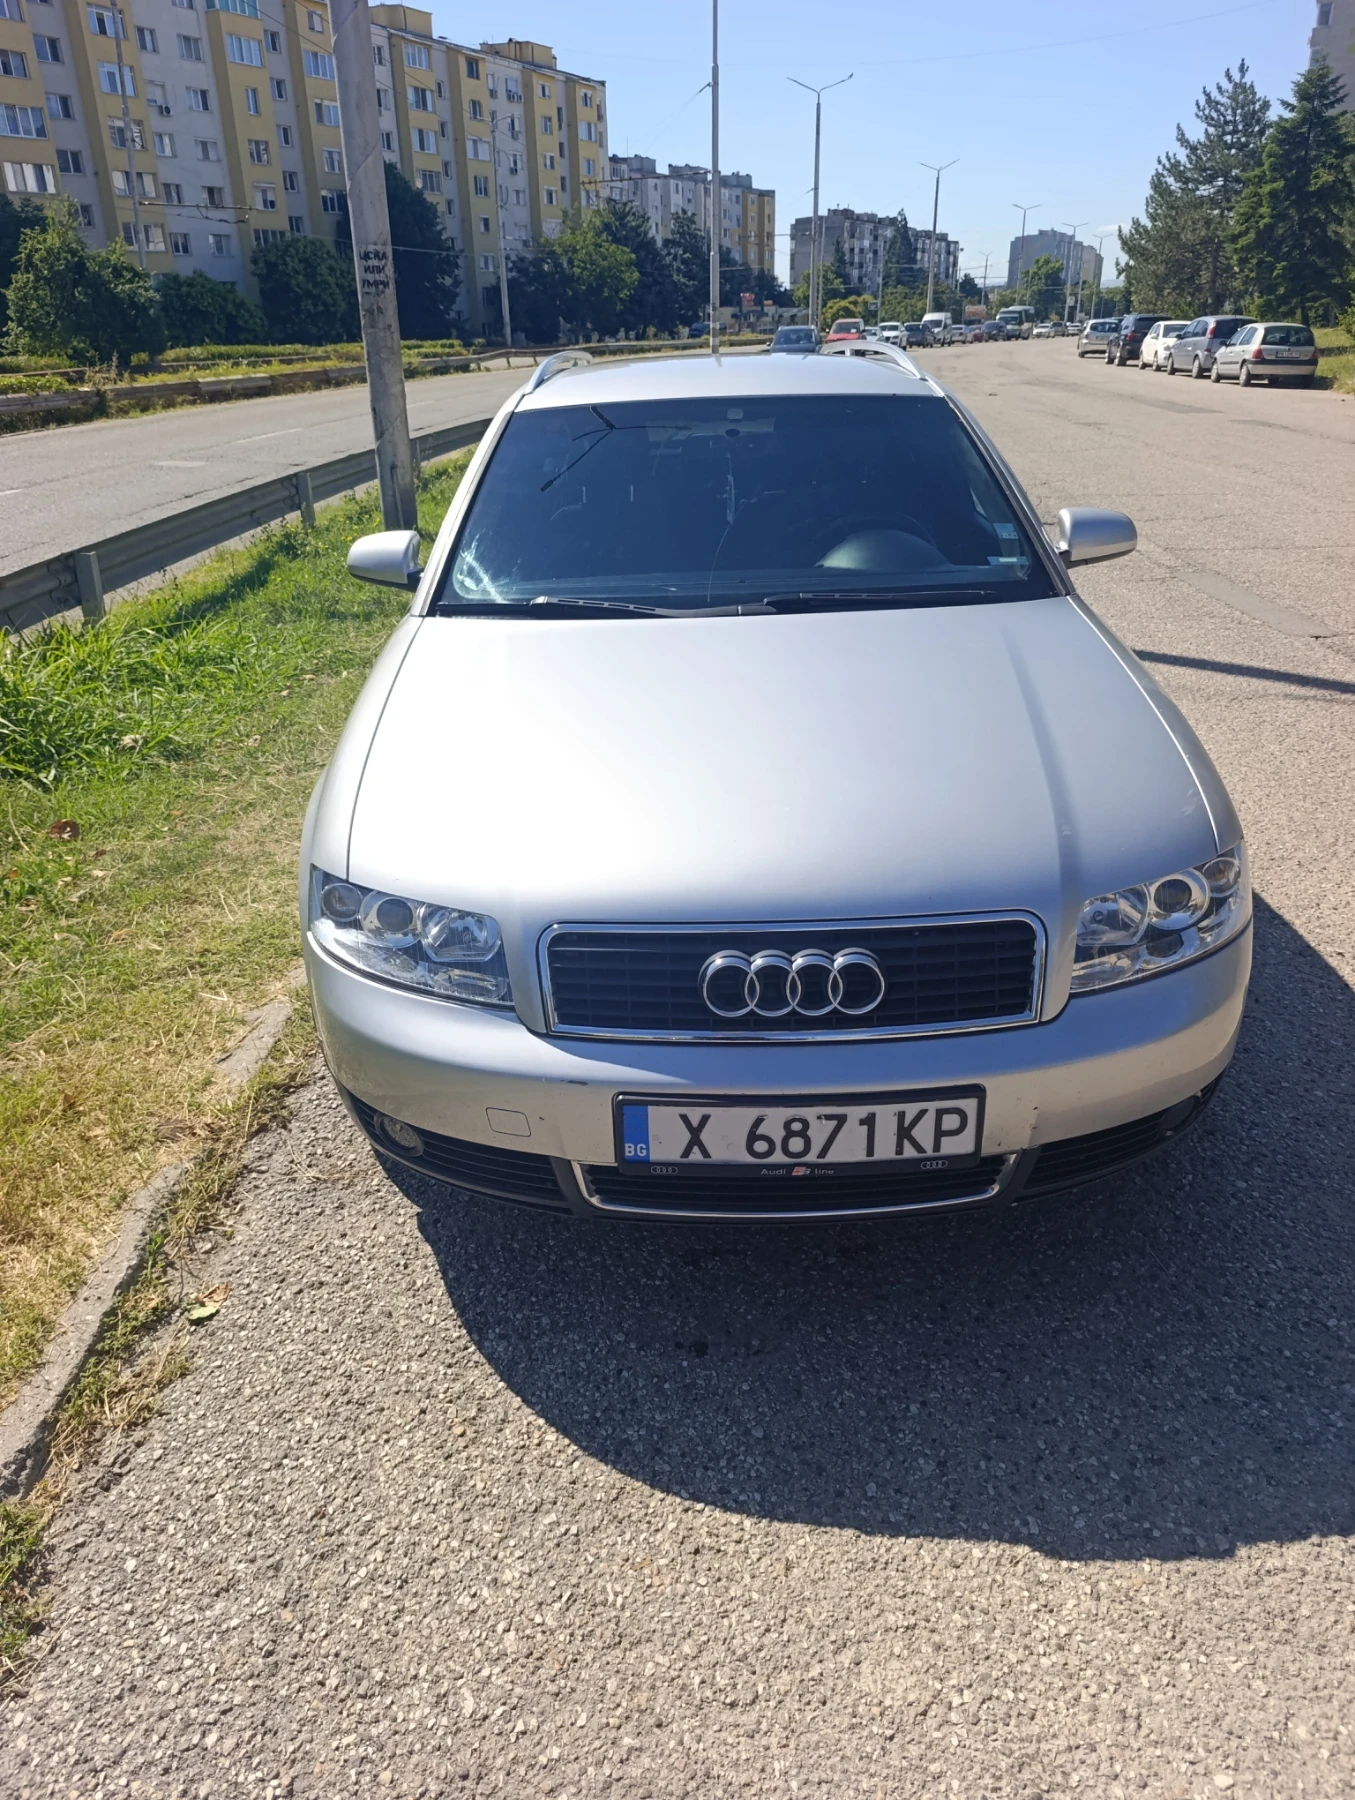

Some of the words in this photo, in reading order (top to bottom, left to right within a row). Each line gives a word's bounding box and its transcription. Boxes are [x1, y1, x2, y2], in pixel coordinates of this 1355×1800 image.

[624, 1143, 647, 1157] BG
[678, 1113, 712, 1159] X
[745, 1112, 876, 1160] 6871
[895, 1107, 968, 1156] KP
